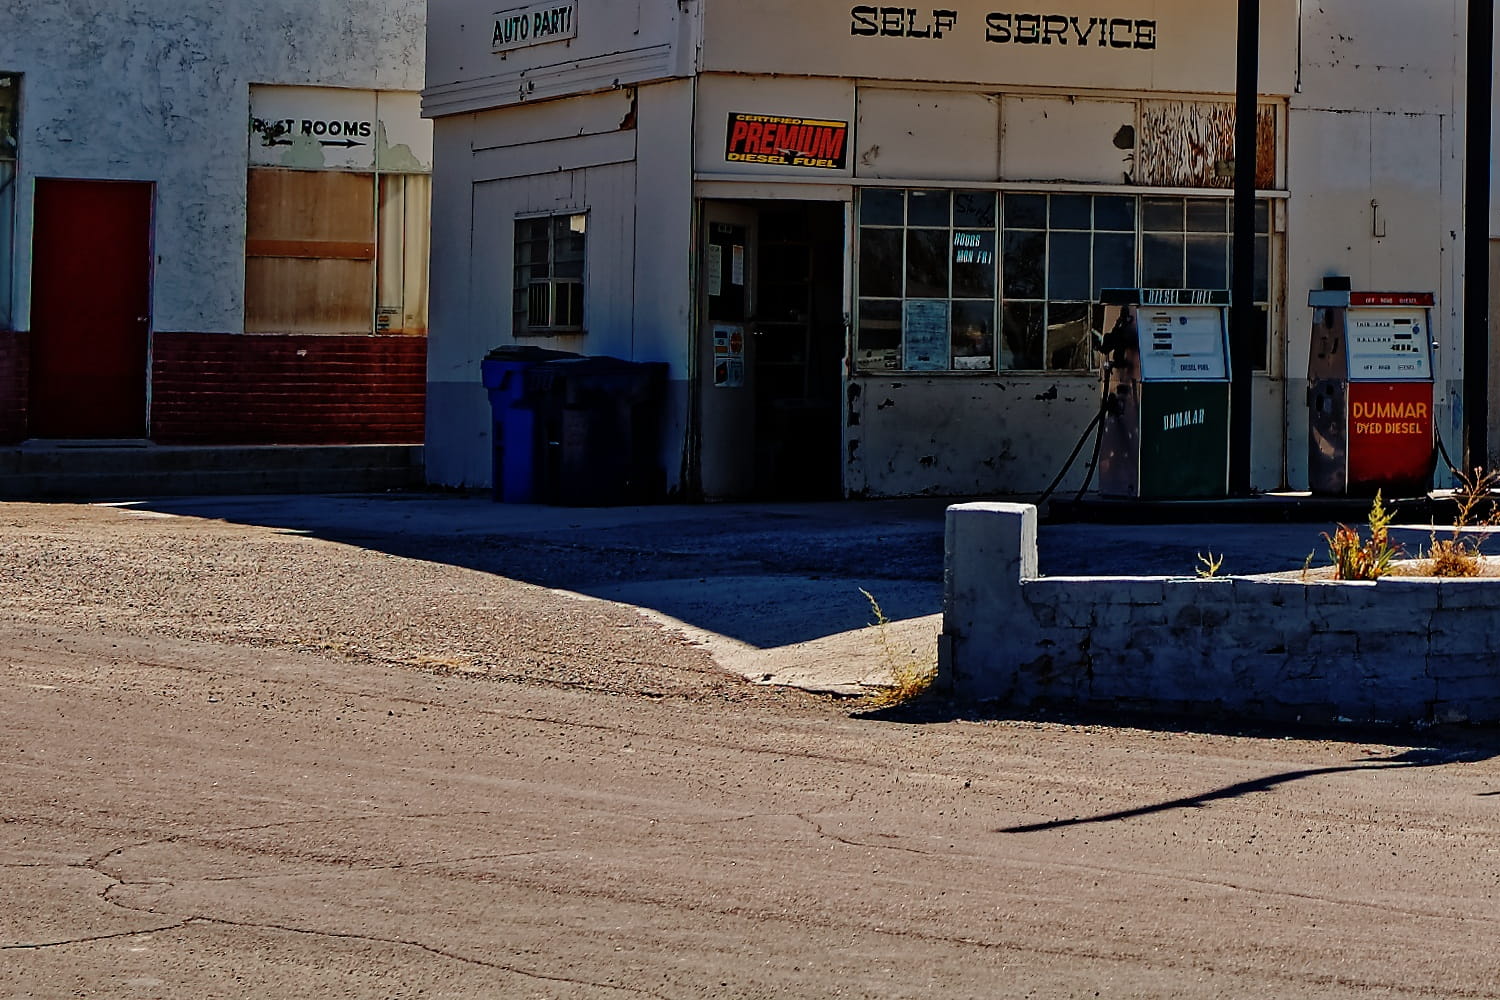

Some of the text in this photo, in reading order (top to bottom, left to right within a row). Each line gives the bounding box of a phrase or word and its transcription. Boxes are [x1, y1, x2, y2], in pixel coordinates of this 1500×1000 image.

[492, 14, 529, 48] AUTO
[851, 6, 1156, 50] SELF SERVICE
[252, 118, 371, 137] RST ROOMS
[736, 114, 802, 125] CERTIFIED
[729, 121, 846, 159] PREMIUM
[727, 152, 837, 168] DIESEL FUEL
[953, 232, 981, 248] HOURS
[956, 249, 974, 264] MON
[1353, 401, 1427, 419] DUMMAR
[1163, 408, 1205, 431] DUMMAR
[1385, 422, 1423, 434] DIESEL
